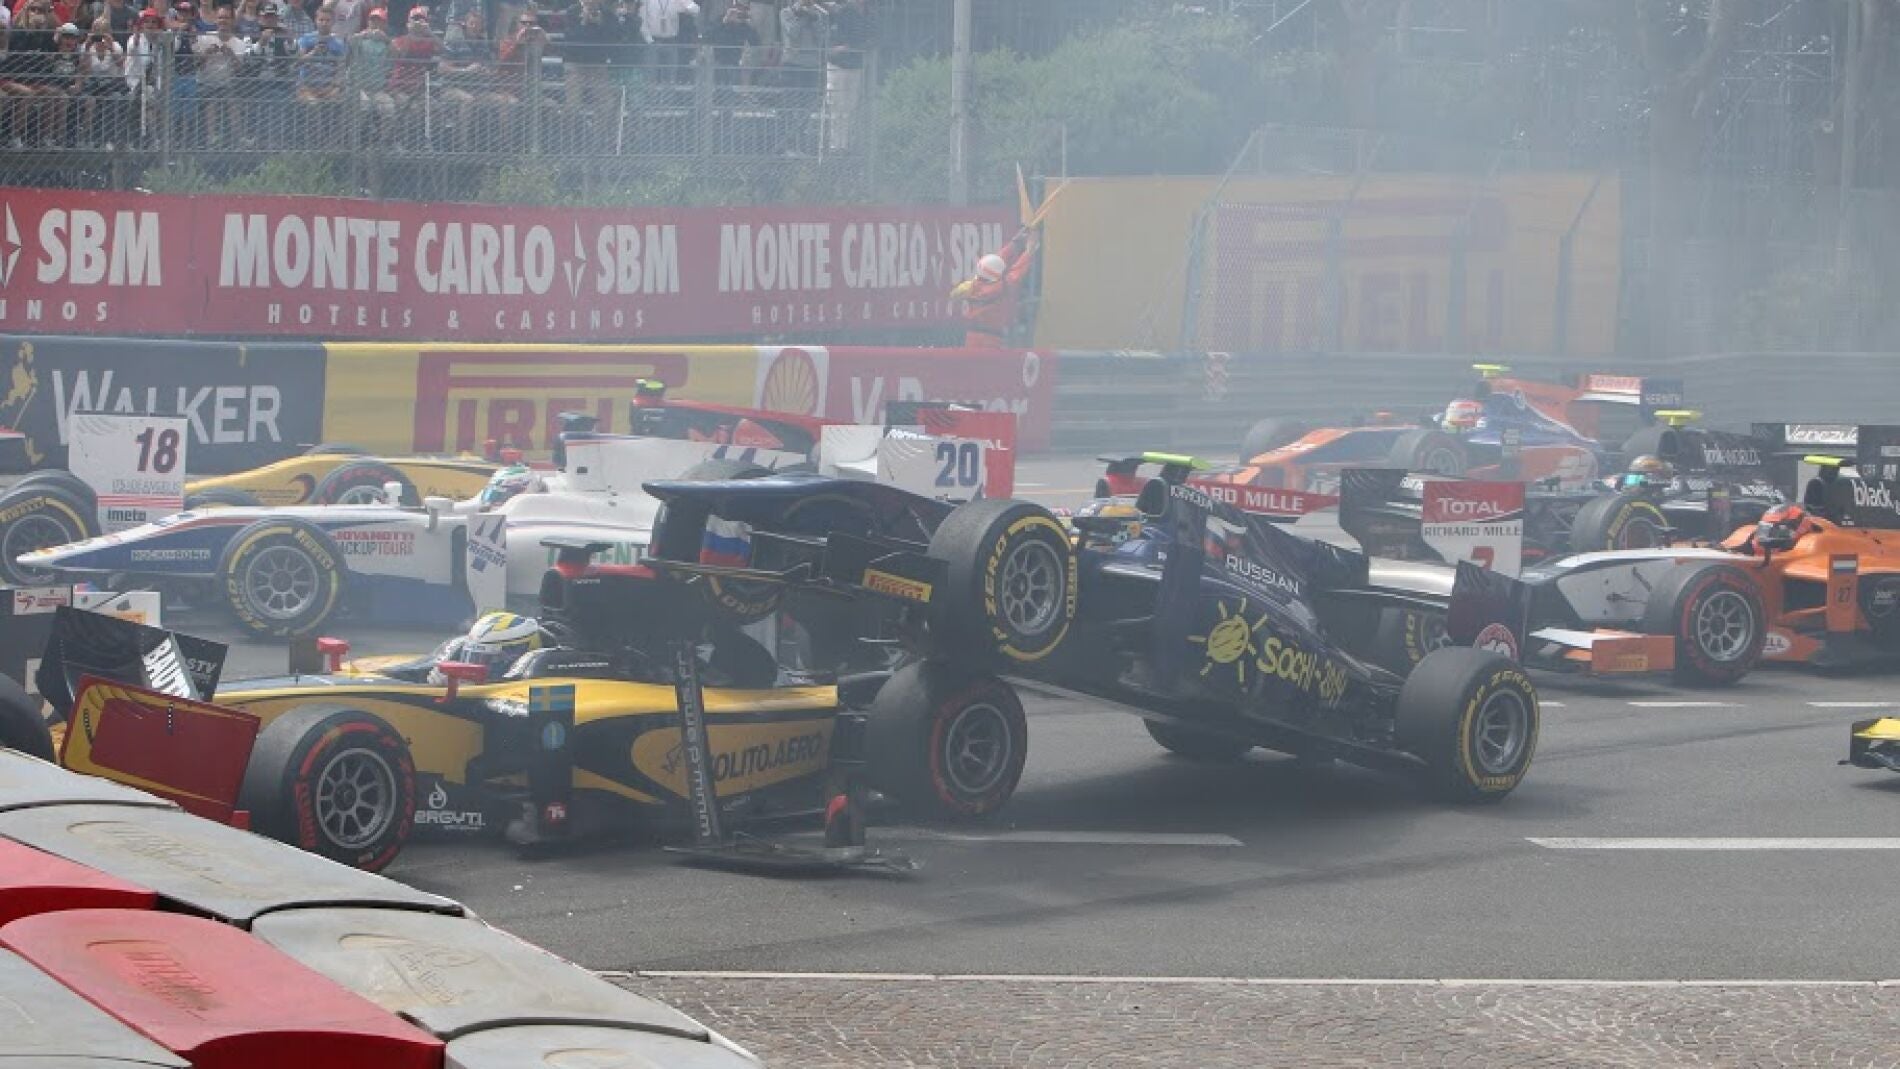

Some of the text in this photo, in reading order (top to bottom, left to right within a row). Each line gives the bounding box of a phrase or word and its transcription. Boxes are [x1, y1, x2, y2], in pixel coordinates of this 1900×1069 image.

[37, 208, 161, 286] SBM
[219, 213, 680, 295] MONTE CARLO SBM
[718, 222, 832, 292] MONTE
[841, 222, 926, 288] CARLO
[268, 304, 643, 330] HOTELS & CASINOS
[752, 302, 844, 324] HOTELS
[892, 299, 971, 319] CASINO
[52, 370, 282, 446] WAKER
[135, 427, 180, 473] 18
[935, 441, 980, 487] 20
[1245, 490, 1305, 512] MILLE
[1436, 497, 1505, 514] TOTAL
[1424, 526, 1521, 537] RICHARD MILLE
[1225, 553, 1300, 594] RUSSIAN
